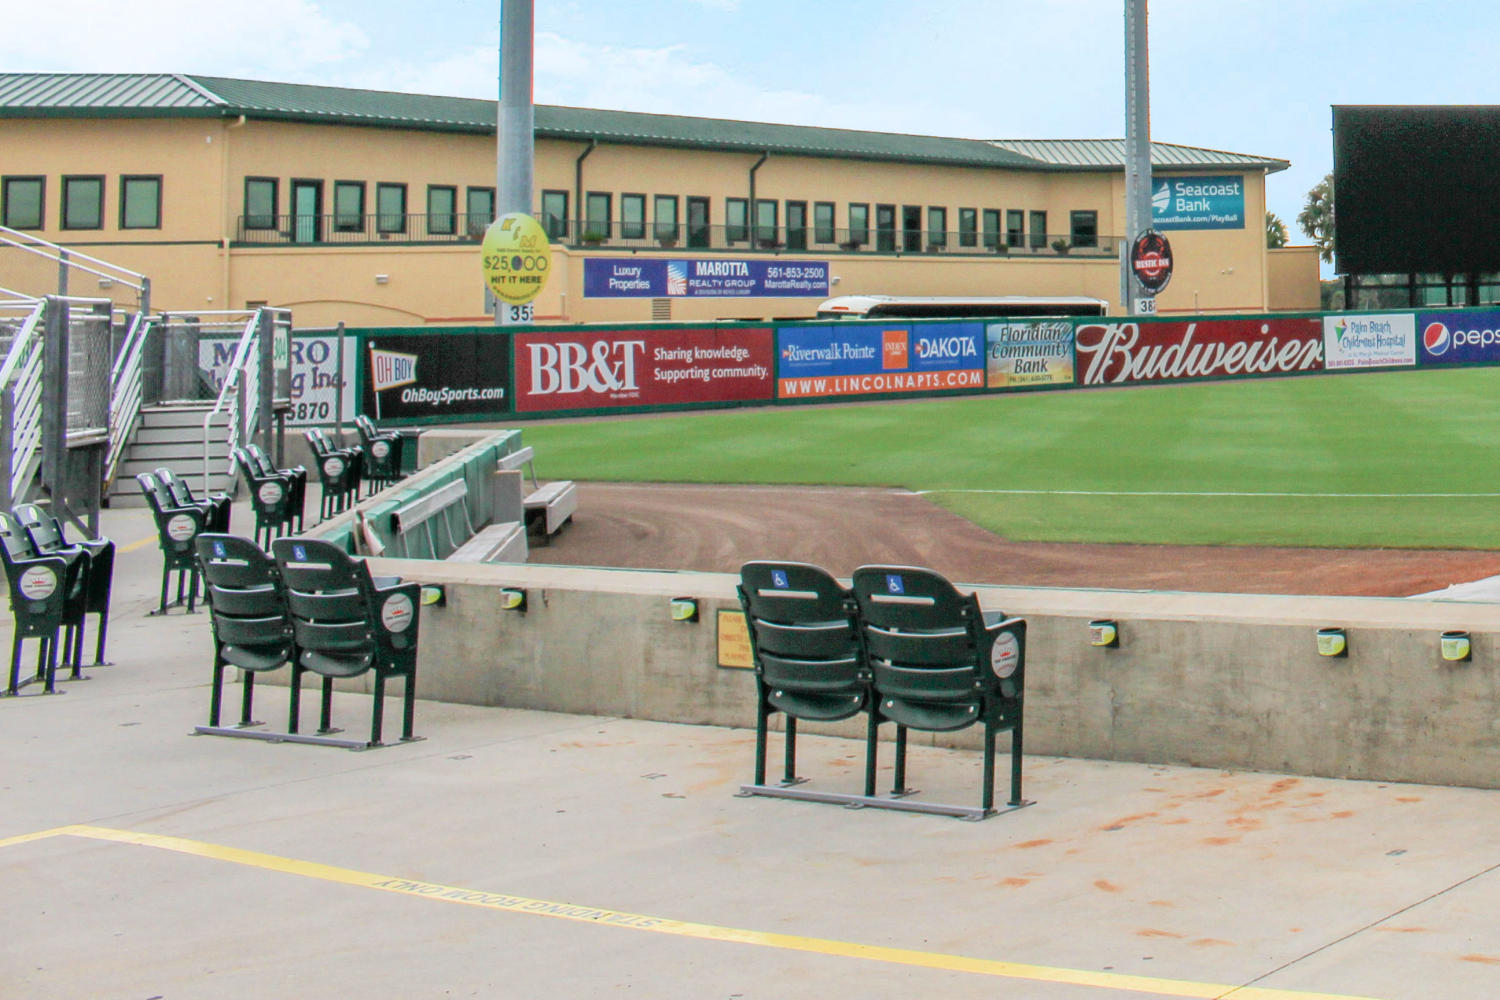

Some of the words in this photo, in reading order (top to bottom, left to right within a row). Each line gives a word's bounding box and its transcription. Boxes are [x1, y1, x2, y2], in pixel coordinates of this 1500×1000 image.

[1175, 182, 1240, 197] Seacoast
[1176, 198, 1210, 212] Bank
[1152, 215, 1238, 223] acoastBank.com/PlayBall
[484, 255, 548, 272] $25,000
[697, 262, 749, 276] MAROTTA
[491, 276, 506, 284] HIT
[509, 276, 517, 284] IT
[520, 275, 542, 284] HERE
[613, 265, 642, 279] Luxury
[767, 267, 824, 279] 561-853-2500
[609, 278, 650, 290] Properties
[764, 279, 828, 290] MarottaRealty.com
[1000, 324, 1061, 342] Floridian
[1351, 321, 1368, 333] Palm
[1369, 320, 1391, 333] Beach
[919, 336, 976, 358] DAKOTA
[1377, 334, 1406, 349] Hospital
[213, 340, 330, 366] MRO
[654, 347, 692, 362] Sharing
[694, 346, 750, 362] knowledge.
[788, 342, 842, 361] Riverwalk
[843, 342, 875, 360] Pointe
[992, 341, 1069, 359] Community
[1076, 323, 1323, 384] Budweiser
[377, 355, 392, 383] OH
[394, 358, 413, 381] BOY
[526, 341, 645, 395] BB&T
[654, 367, 710, 383] Supporting
[712, 364, 768, 380] community.
[1015, 358, 1048, 374] Bank
[785, 372, 981, 394] WWW.LINCOLNAPTS.COM
[401, 387, 504, 405] OhBoySports.com
[375, 879, 444, 894] ONLY
[445, 889, 519, 907] ROOM
[523, 901, 662, 929] STANDING
